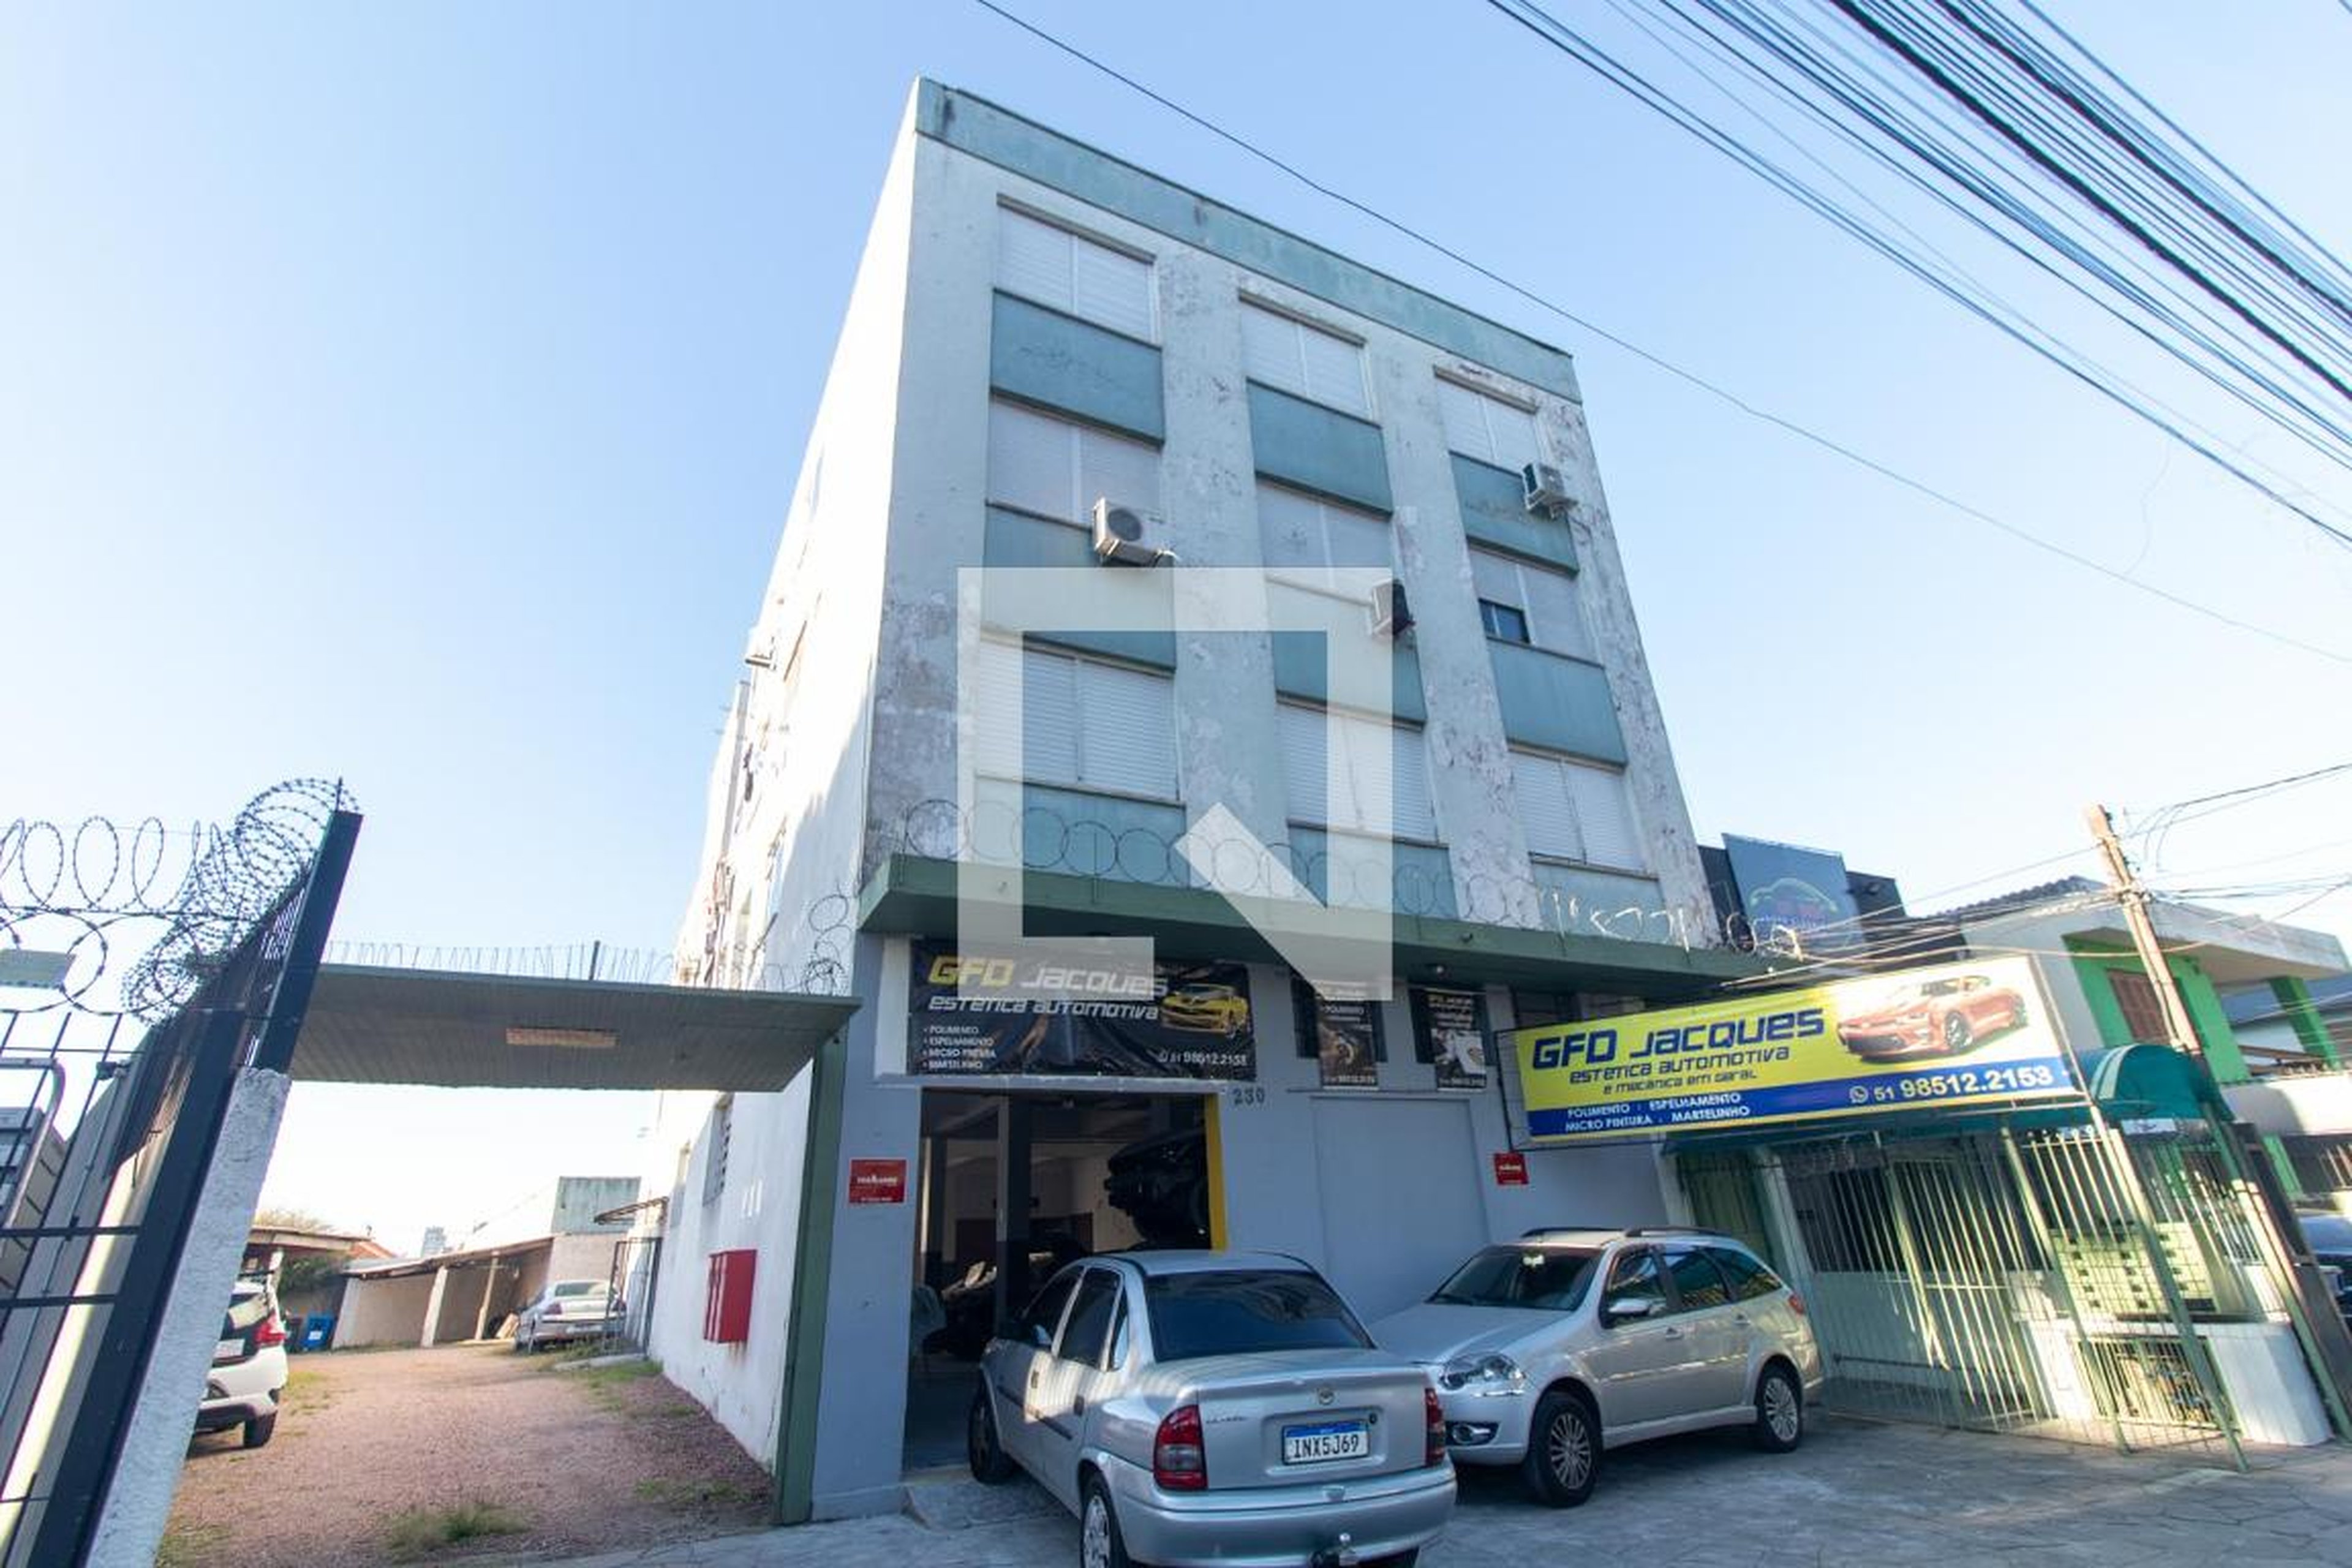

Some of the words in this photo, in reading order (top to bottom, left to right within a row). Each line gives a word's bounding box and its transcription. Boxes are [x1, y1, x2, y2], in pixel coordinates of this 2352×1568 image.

[1658, 1046, 1790, 1073] automotiva
[1603, 1085, 1612, 1095] e
[1687, 1072, 1712, 1085] em
[1874, 1087, 1895, 1101] 51
[1900, 1065, 2052, 1097] 98512.2153
[1232, 1087, 1265, 1105] 230
[1566, 1119, 1604, 1132] MICRO
[1605, 1114, 1653, 1129] PINTURA
[1671, 1105, 1751, 1123] MARTELINHO
[1567, 1103, 1630, 1118] POLIMENTO
[1293, 1434, 1359, 1458] INX5J69
